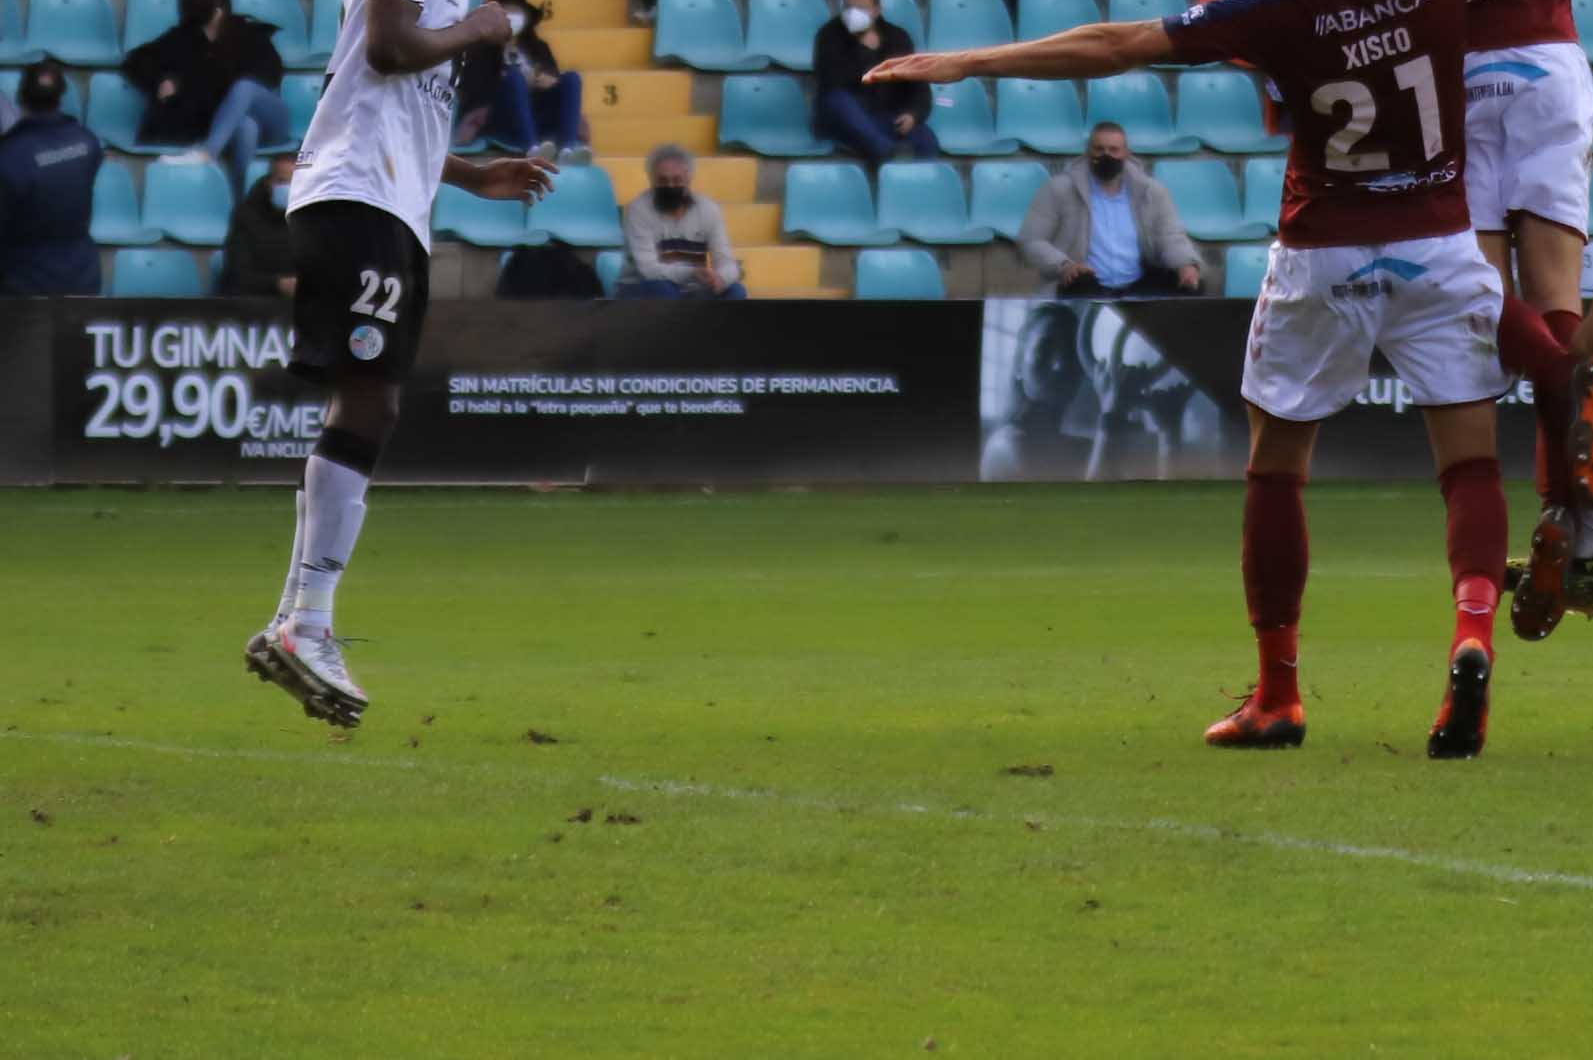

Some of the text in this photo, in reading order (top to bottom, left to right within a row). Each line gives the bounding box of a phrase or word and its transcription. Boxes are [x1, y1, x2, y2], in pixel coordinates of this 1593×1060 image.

[1341, 27, 1412, 70] XISCO
[1310, 53, 1445, 172] 21
[351, 269, 400, 323] 22
[86, 326, 295, 369] TU GIMNA
[449, 374, 899, 394] SIN MATRÍCULAS NI CONDICIONES DE PERMANENCIA.
[450, 400, 465, 413] Di
[636, 402, 661, 416] que
[665, 400, 677, 413] te
[681, 400, 744, 413] beneficia.
